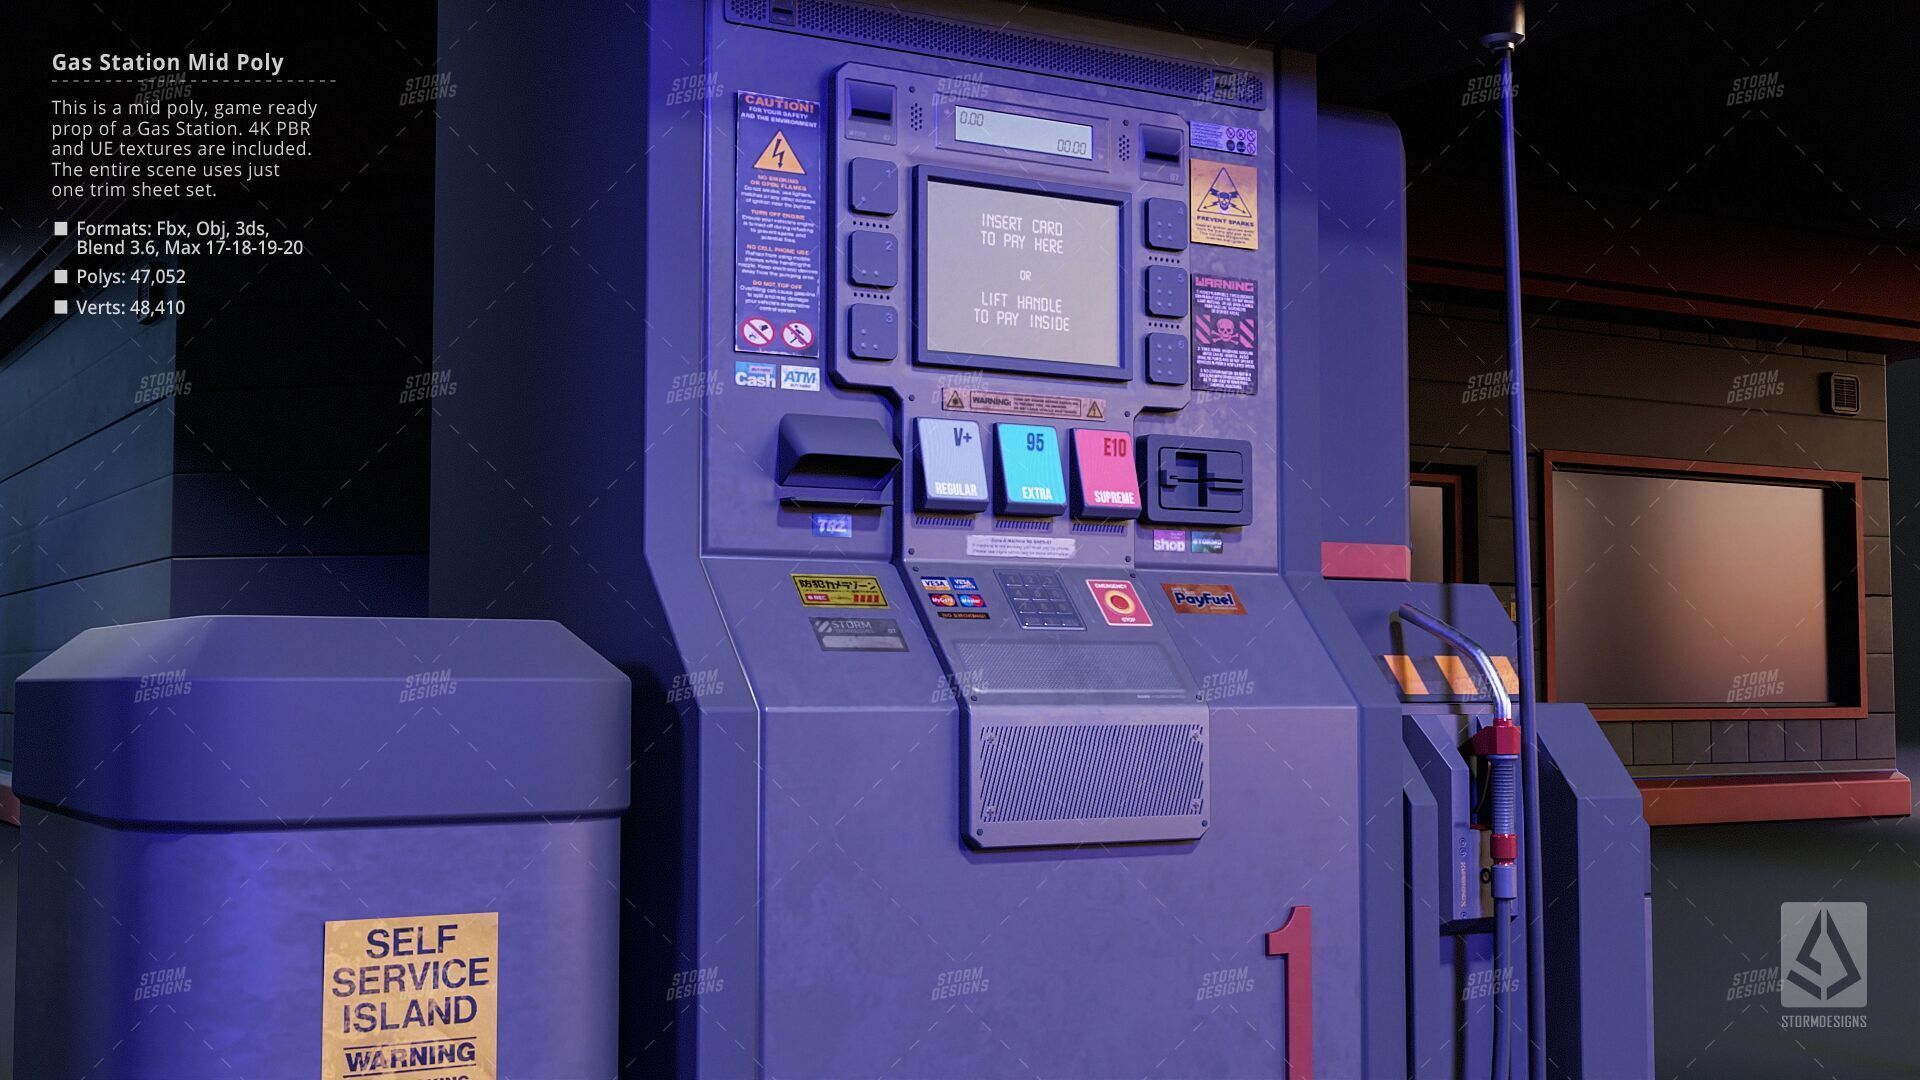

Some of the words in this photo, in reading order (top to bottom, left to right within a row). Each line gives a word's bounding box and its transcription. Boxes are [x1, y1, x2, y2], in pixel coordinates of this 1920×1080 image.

[745, 95, 814, 113] CAUTION!
[783, 111, 808, 120] SAFETY
[960, 111, 984, 127] 0.00
[1056, 139, 1087, 155] 00.00
[982, 213, 1022, 231] INSERT
[1032, 219, 1063, 236] CARD
[1197, 215, 1227, 224] PREVENT
[981, 231, 995, 246] TO
[1004, 234, 1025, 249] PAY
[1035, 238, 1063, 254] HERE
[1020, 270, 1031, 280] OR
[1195, 277, 1254, 292] WARNING
[981, 292, 1008, 308] LIFT
[1018, 296, 1062, 313] HANDLE
[974, 309, 988, 323] TO
[997, 311, 1019, 326] PAY
[1030, 315, 1070, 331] INSIDE
[735, 371, 776, 388] Cash
[784, 370, 816, 383] ATM
[973, 397, 1011, 406] WARNING:
[953, 428, 972, 447] V+
[1026, 432, 1044, 452] 95
[1104, 438, 1126, 457] E10
[935, 482, 978, 497] REGULAR
[1022, 486, 1052, 500] EXTRA
[1094, 490, 1136, 505] SUPREME
[1154, 538, 1186, 551] shop
[1174, 592, 1235, 607] PayFuel
[831, 620, 872, 629] STORM
[366, 924, 458, 959] SELF
[332, 957, 489, 997] SERVICE
[1266, 905, 1312, 1080] 1
[343, 995, 478, 1033] ISLAND
[345, 1042, 475, 1072] WARNING
